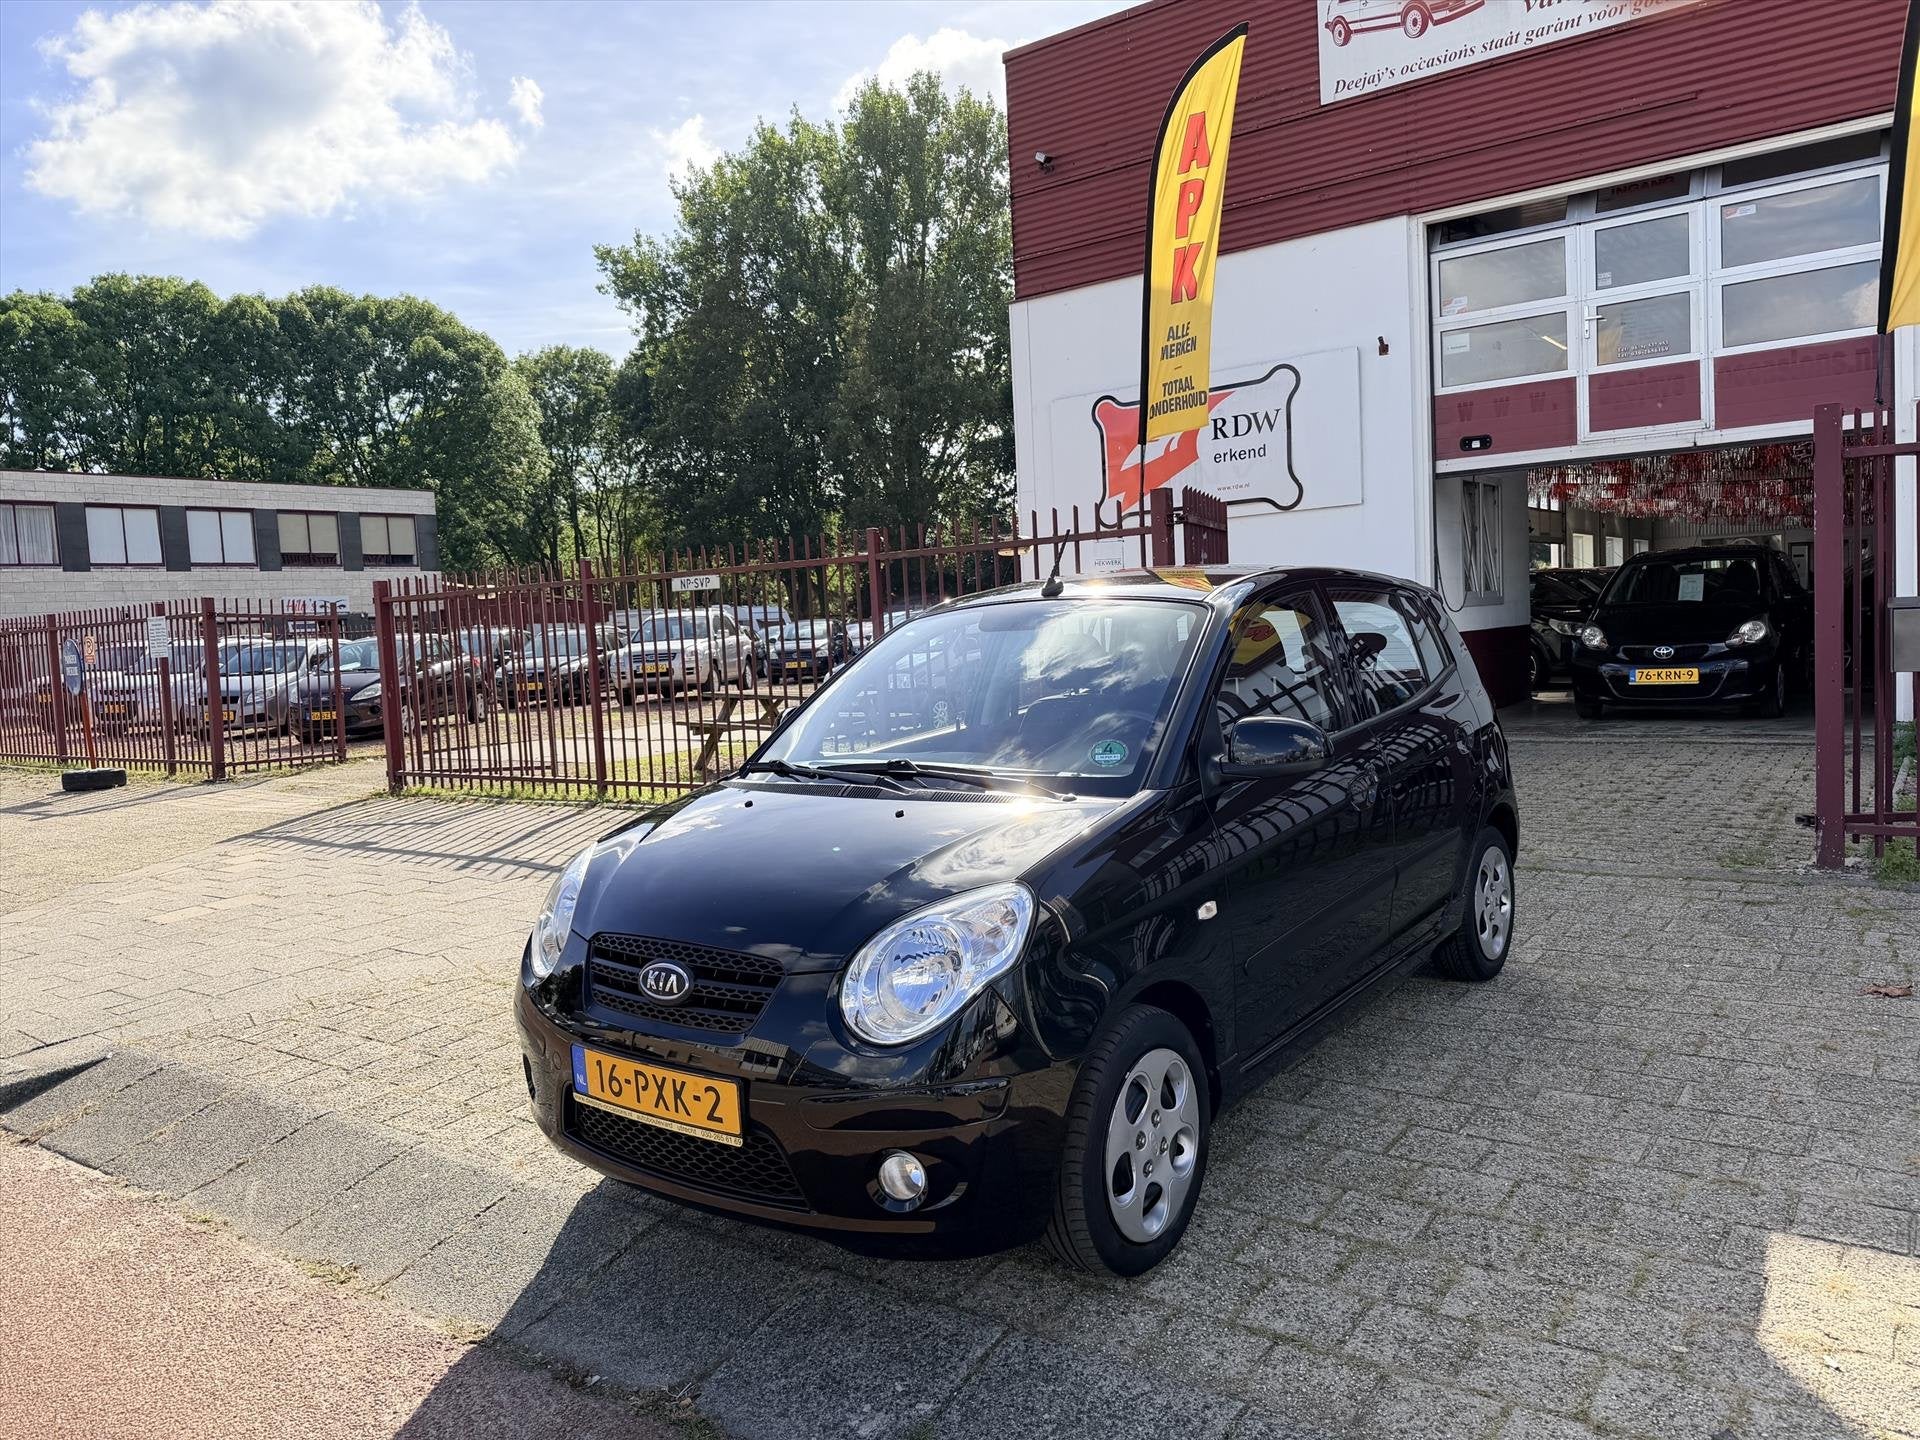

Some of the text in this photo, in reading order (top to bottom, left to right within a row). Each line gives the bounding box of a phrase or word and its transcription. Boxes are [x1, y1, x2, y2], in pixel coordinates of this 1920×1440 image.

[1334, 66, 1396, 94] Deejay's
[1400, 44, 1476, 75] occasions
[1480, 31, 1521, 53] staat
[1525, 14, 1582, 45] garant
[1588, 4, 1627, 23] voor
[1170, 111, 1211, 304] APK
[1167, 321, 1190, 341] ALLE
[1162, 376, 1195, 398] TOTAAL
[1149, 391, 1208, 420] ONDERHOUD
[1211, 408, 1281, 440] RDW
[1213, 444, 1267, 463] erkend
[680, 577, 711, 589] NP-SVP
[1638, 670, 1694, 680] 76-KRN-9
[647, 970, 678, 993] KIA
[576, 1073, 587, 1086] NL
[596, 1059, 724, 1124] 16-PXK-2
